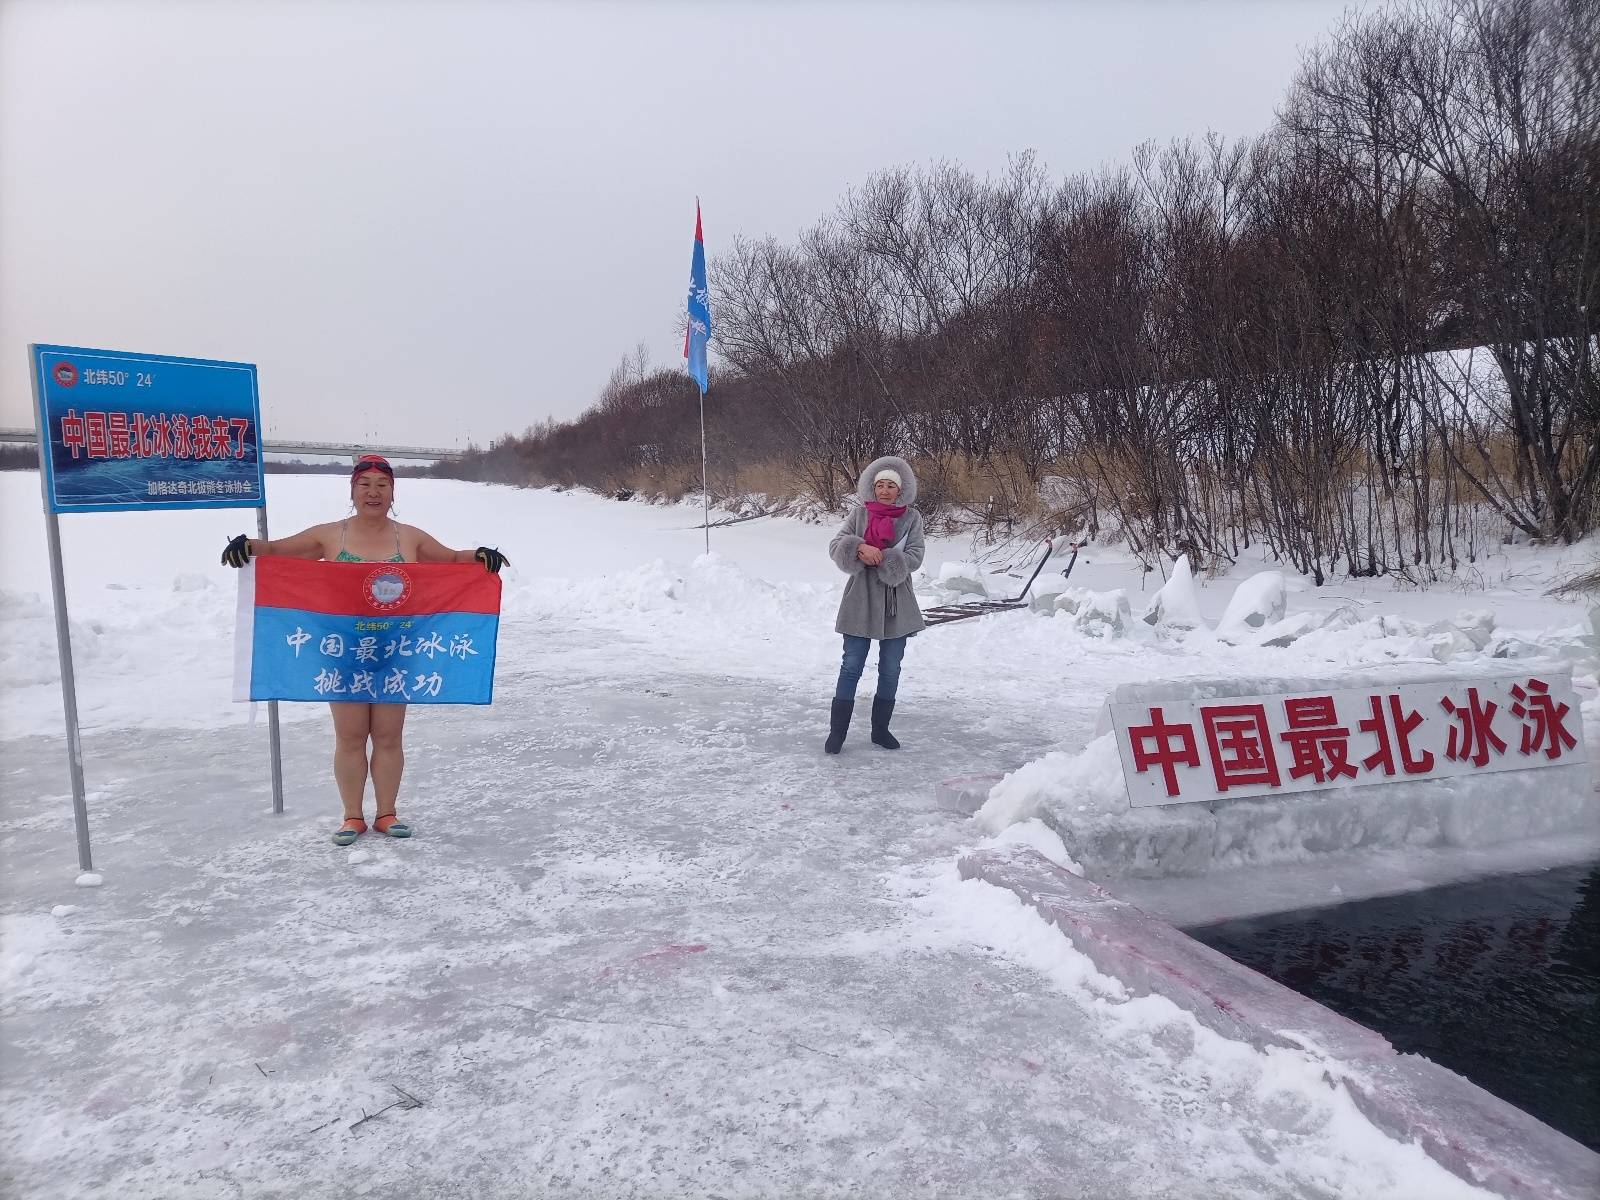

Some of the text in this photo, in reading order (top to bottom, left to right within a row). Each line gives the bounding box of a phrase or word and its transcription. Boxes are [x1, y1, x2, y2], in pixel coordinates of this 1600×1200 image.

[61, 408, 249, 459] 中国最北冰泳我来了
[147, 479, 253, 496] 加格达奇北极熊冬泳协会
[286, 626, 479, 663] 中国最北冰泳
[313, 667, 444, 700] 挑战成功
[1127, 678, 1578, 797] 中国最北冰泳
